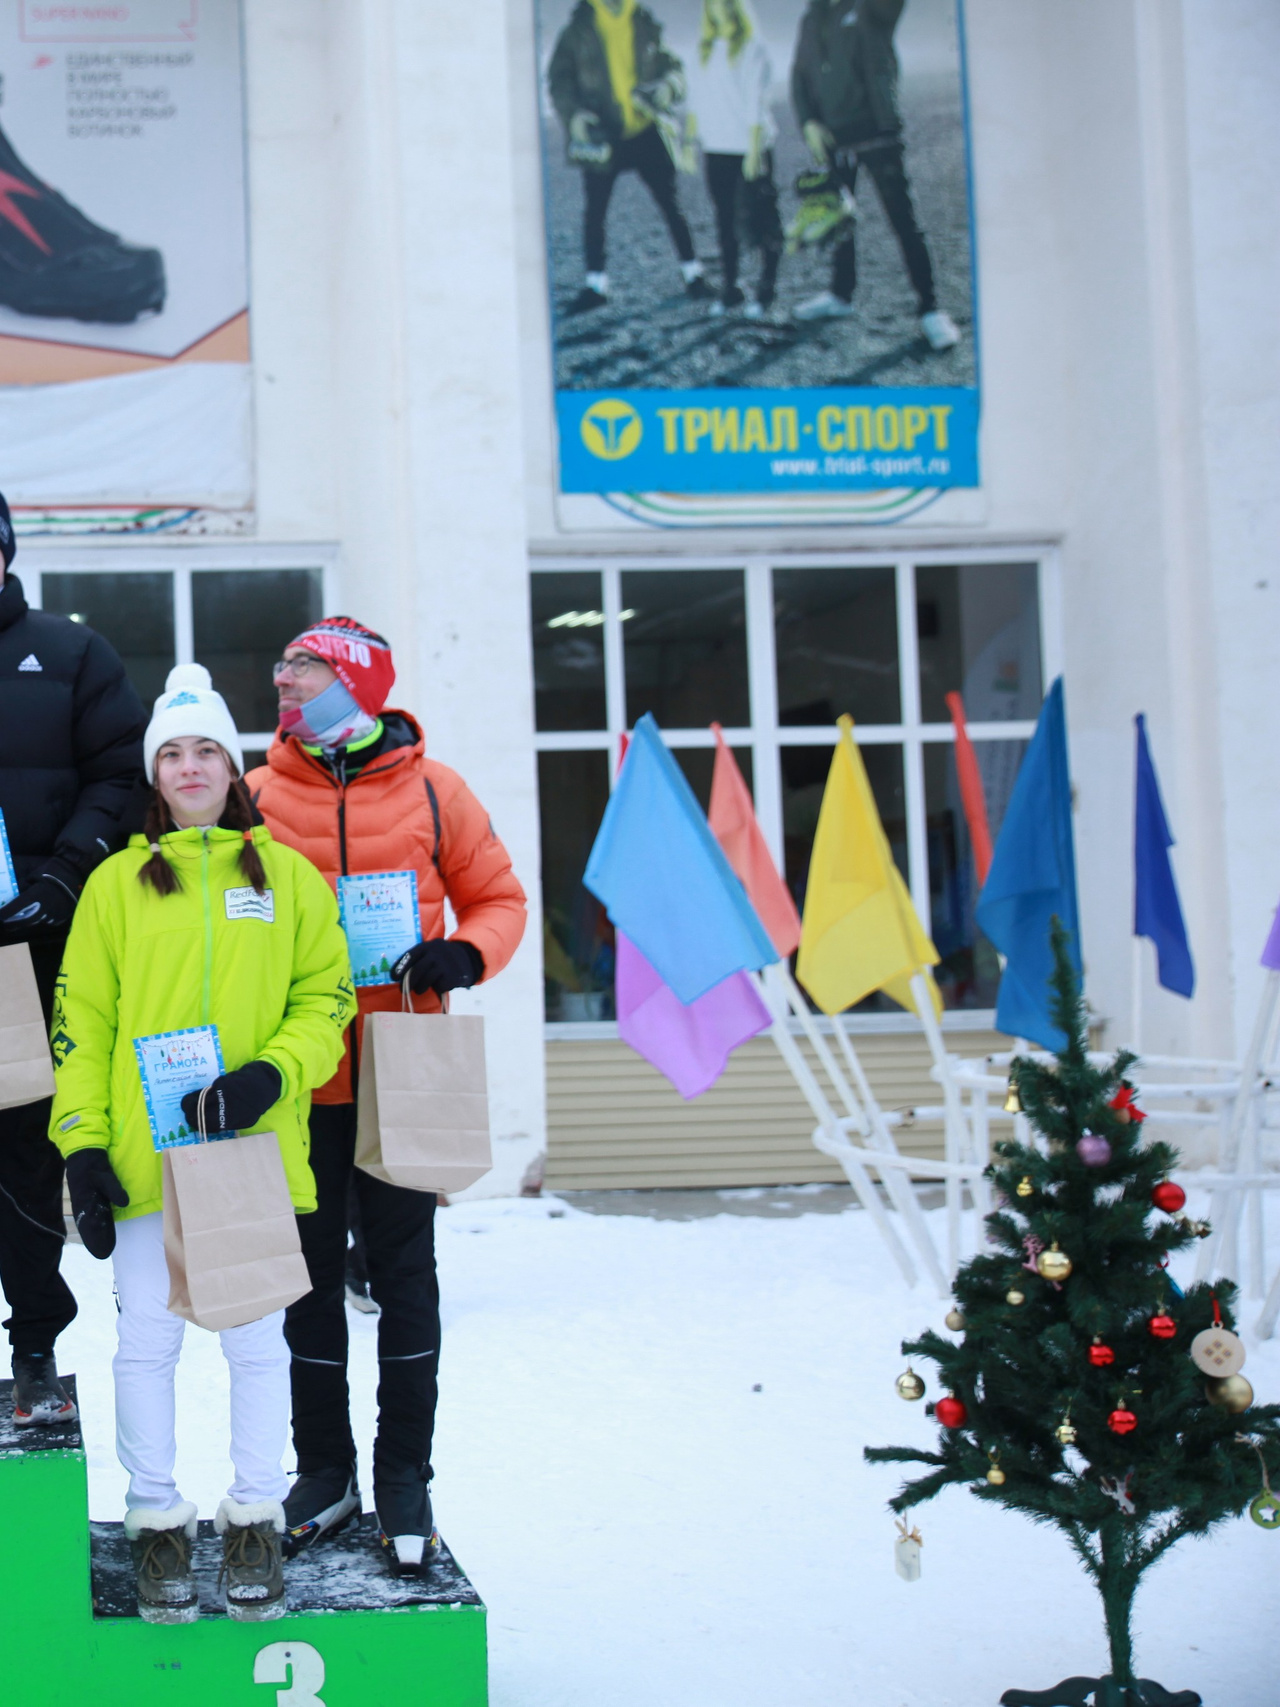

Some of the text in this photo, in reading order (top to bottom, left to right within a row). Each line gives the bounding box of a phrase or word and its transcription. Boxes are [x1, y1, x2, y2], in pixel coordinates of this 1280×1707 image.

[153, 1056, 208, 1072] ГРАМОТА
[216, 1089, 226, 1129] NORDSKI
[253, 1641, 327, 1707] 3
